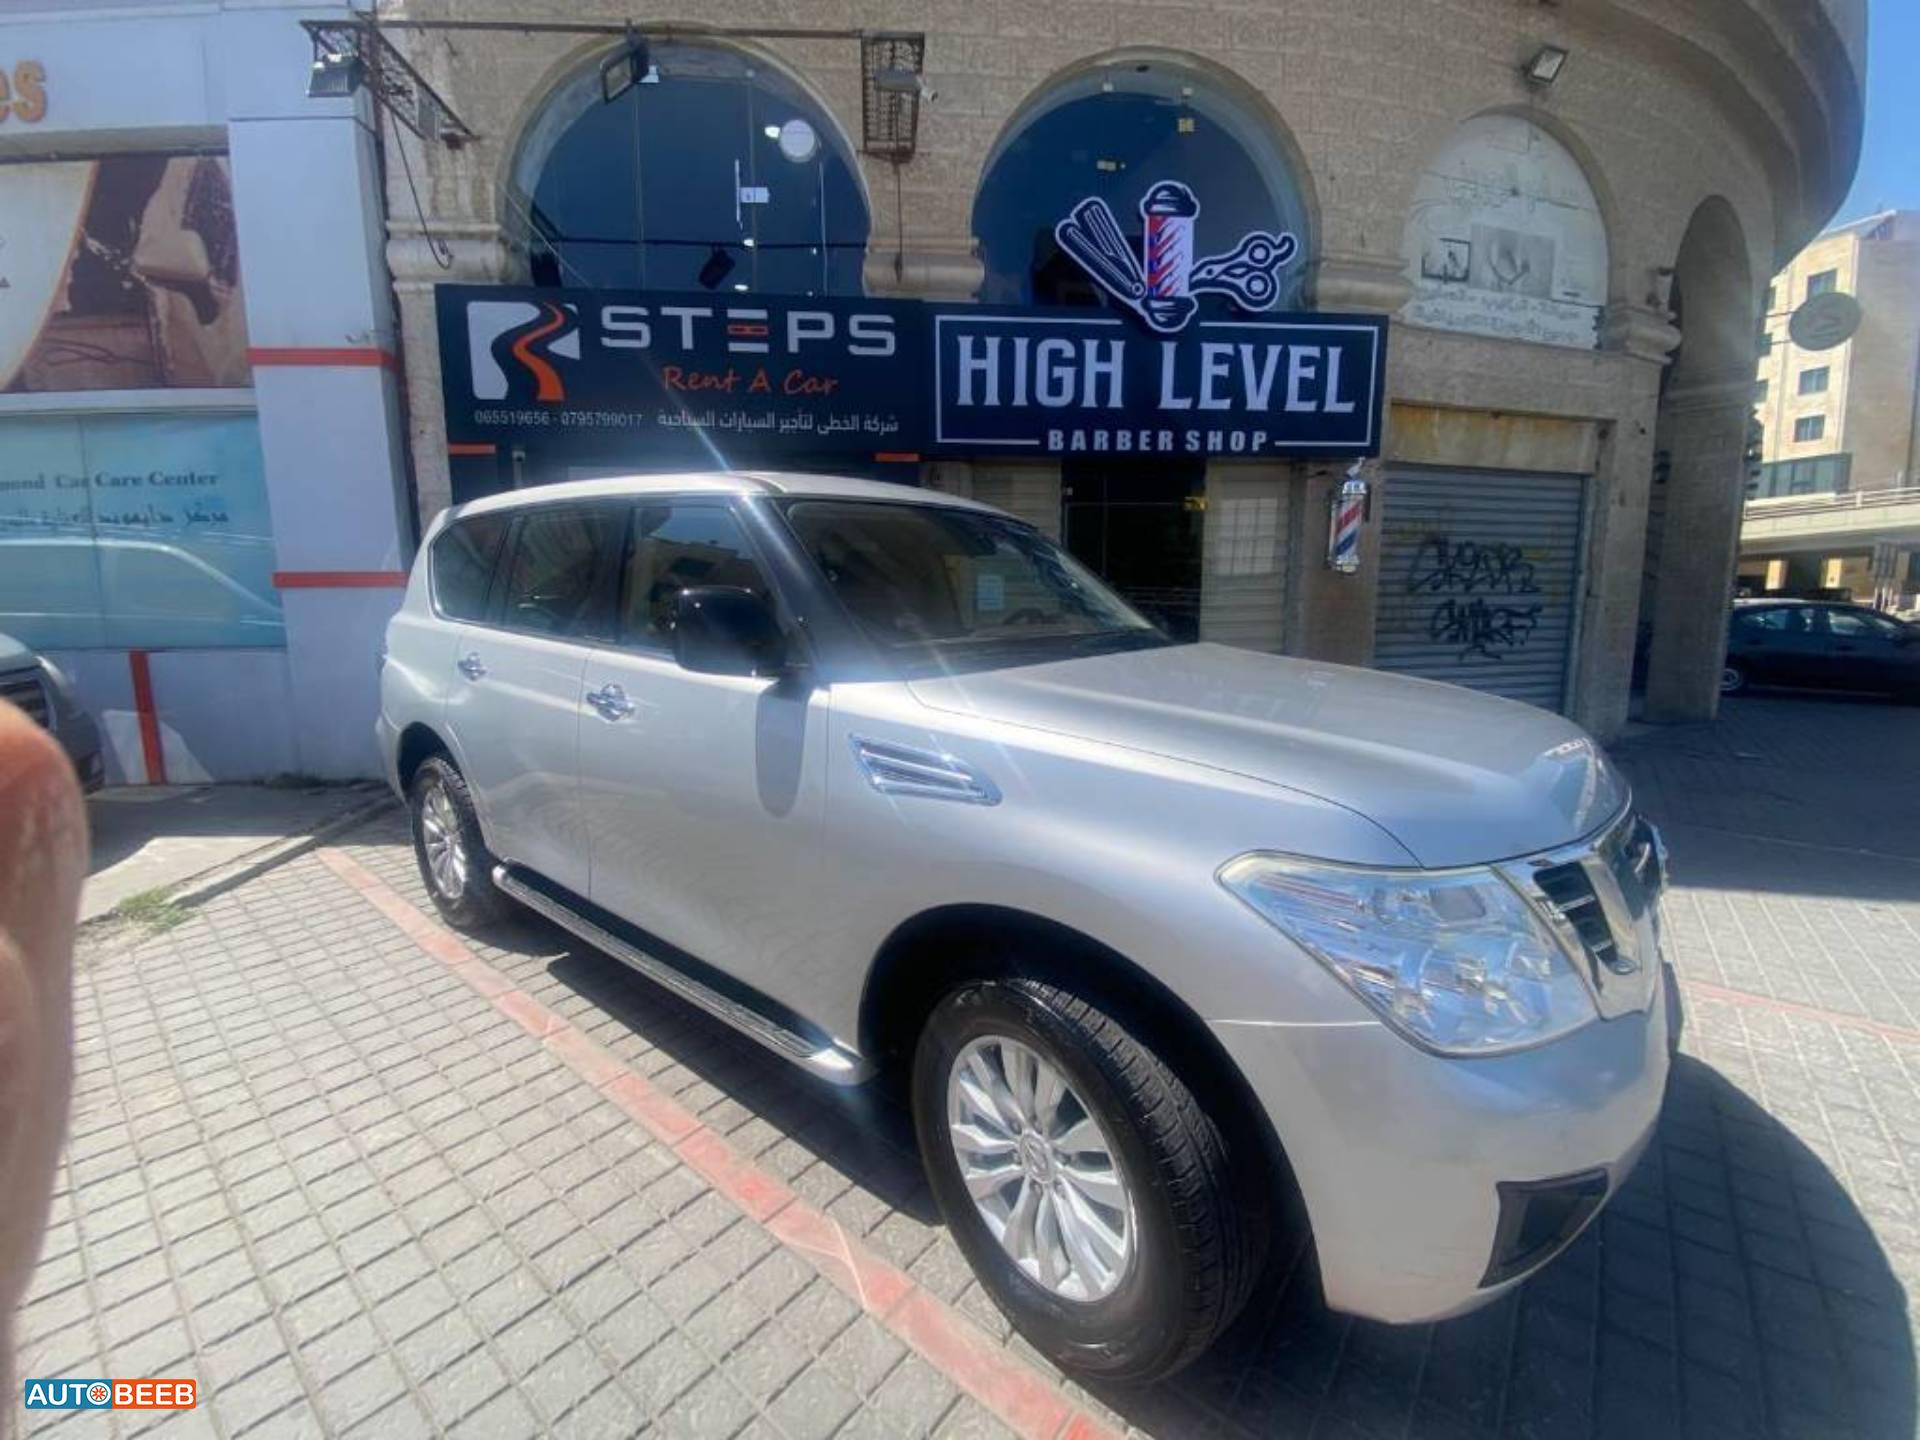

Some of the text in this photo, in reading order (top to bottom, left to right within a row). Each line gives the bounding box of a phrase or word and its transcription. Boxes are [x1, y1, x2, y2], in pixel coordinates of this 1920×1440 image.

[600, 305, 896, 357] STEPS
[662, 365, 839, 396] Rent A Car
[956, 335, 1356, 414] HIGH LEVEL
[719, 409, 775, 433] السيارات
[864, 412, 900, 436] شركة
[1047, 428, 1269, 452] BARBER SHOP
[94, 471, 143, 488] Care
[149, 470, 218, 487] Center
